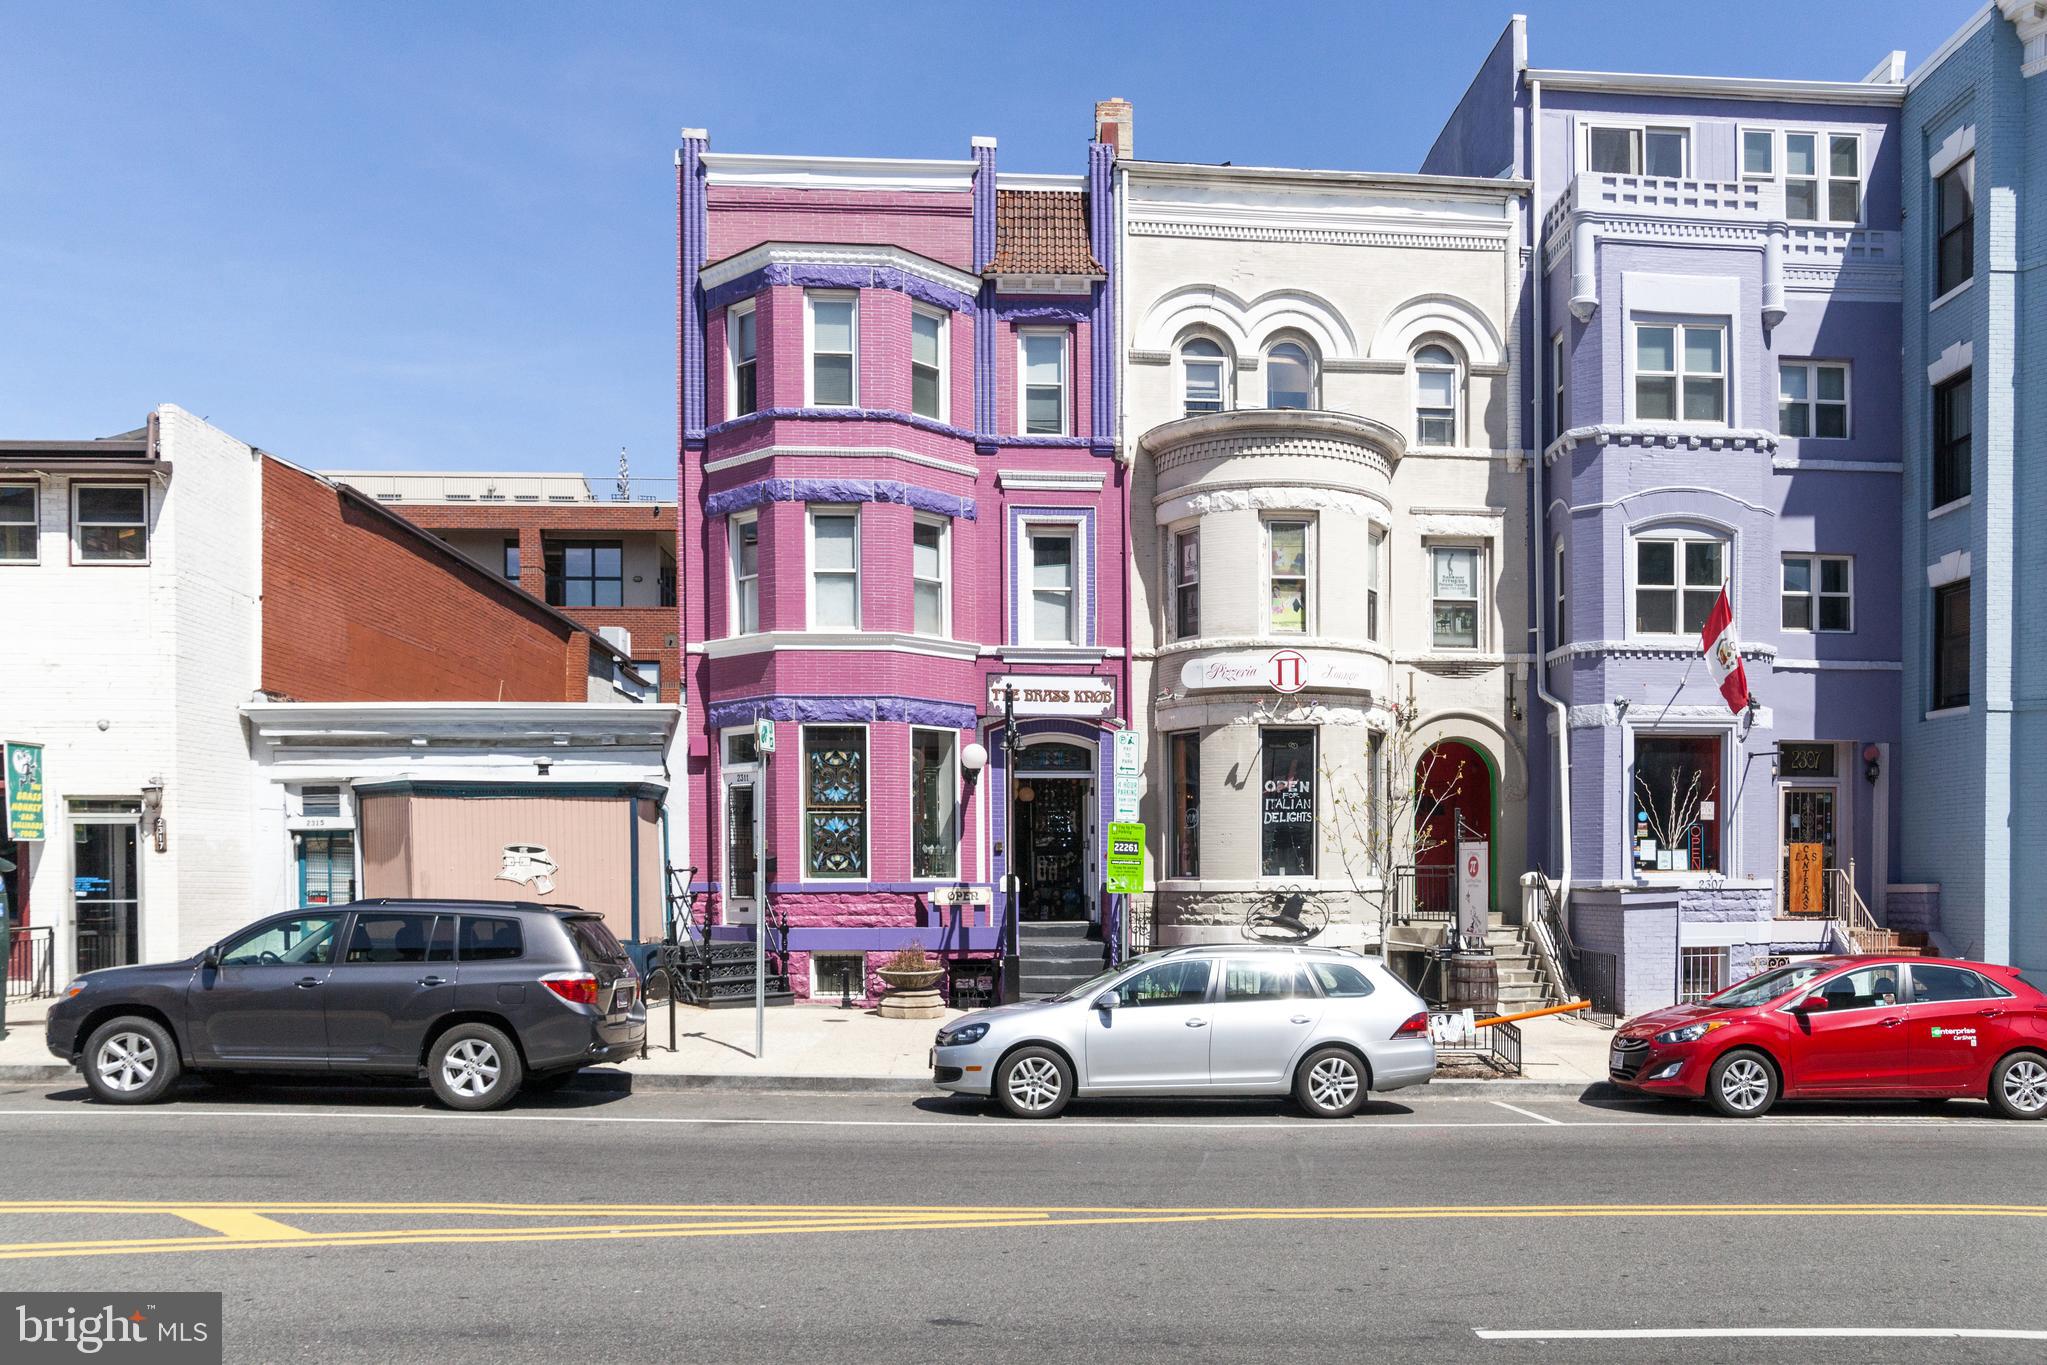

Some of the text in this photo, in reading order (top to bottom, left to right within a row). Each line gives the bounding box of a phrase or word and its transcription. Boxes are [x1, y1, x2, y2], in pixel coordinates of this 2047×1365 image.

[1207, 662, 1257, 682] Pizzeria
[1023, 689, 1071, 703] BRASS
[1074, 690, 1113, 704] KNOB
[1791, 750, 1821, 769] 2307
[736, 774, 749, 782] 2311
[1123, 781, 1137, 789] HOUR
[1264, 780, 1310, 793] OPEN
[16, 791, 42, 801] BRASS
[11, 802, 43, 812] MONKEY
[1265, 798, 1312, 811] ITALIAN
[306, 819, 325, 827] 2315
[1263, 811, 1313, 825] DELIGHTS
[156, 818, 164, 850] 2317
[1114, 842, 1139, 853] 22261
[1691, 825, 1701, 871] OPEN
[1801, 845, 1810, 910] CANTERAS
[947, 891, 979, 901] OPEN
[1934, 1027, 1976, 1036] enterprise
